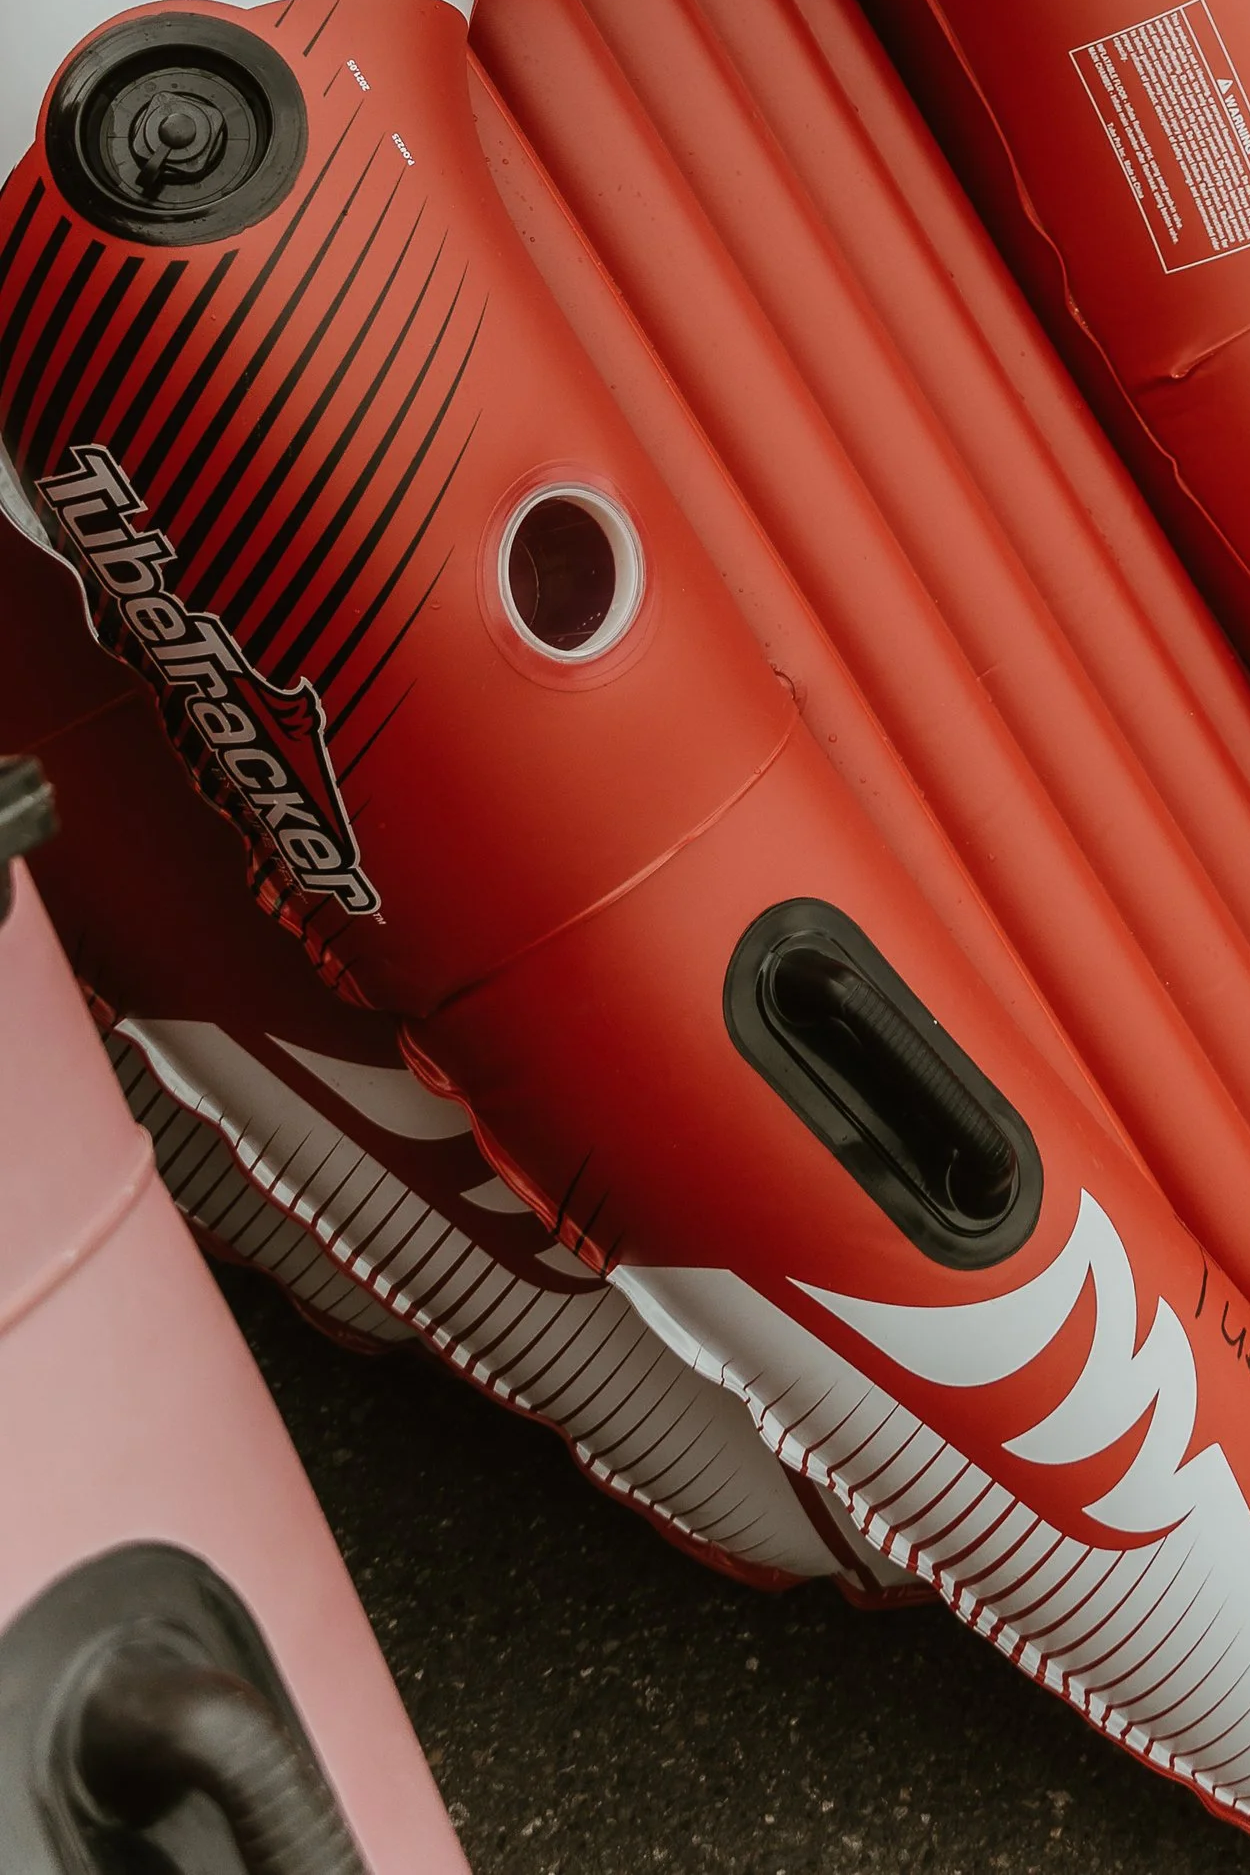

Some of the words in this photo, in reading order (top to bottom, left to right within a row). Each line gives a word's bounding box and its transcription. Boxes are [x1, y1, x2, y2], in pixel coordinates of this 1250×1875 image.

[346, 59, 370, 92] 2021.05
[1095, 61, 1113, 92] CHAMBER
[1097, 42, 1117, 79] INFLATABLE
[1113, 78, 1127, 100] FLOOR
[38, 446, 377, 912] TubeTracker
